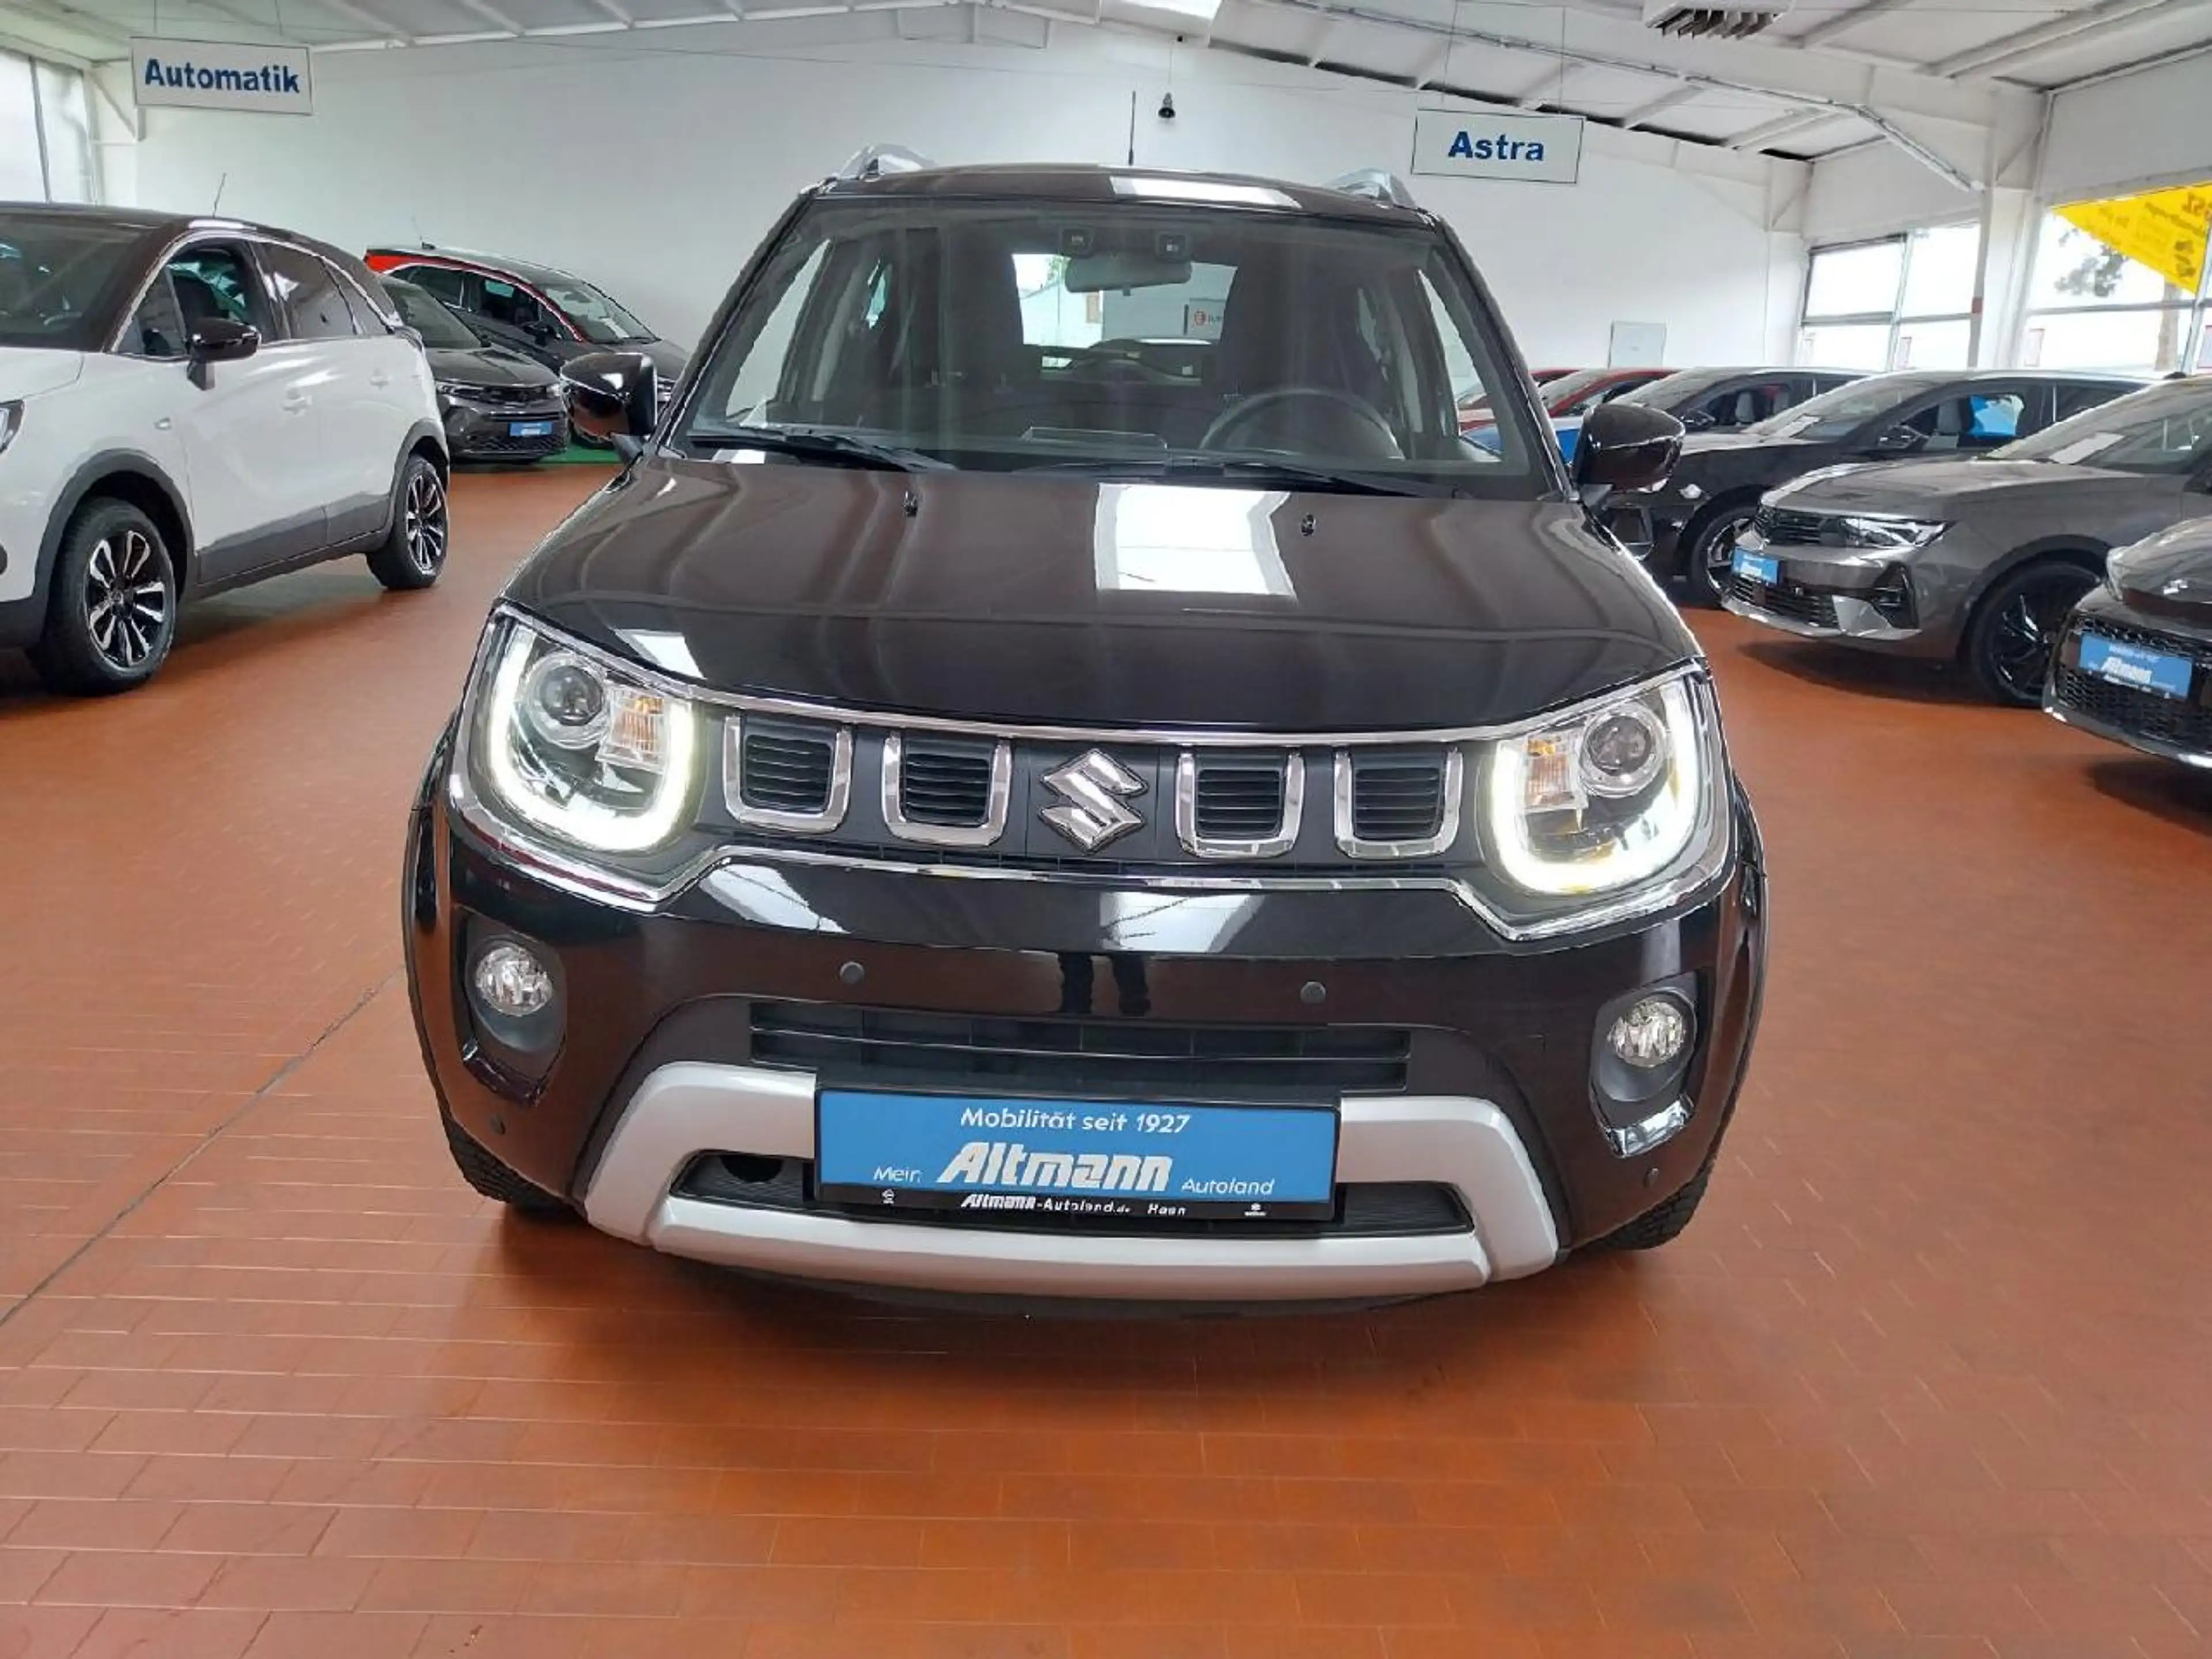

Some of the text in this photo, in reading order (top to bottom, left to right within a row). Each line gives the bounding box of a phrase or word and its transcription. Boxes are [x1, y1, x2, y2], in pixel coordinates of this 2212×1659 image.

[145, 58, 300, 93] Automatik
[1448, 131, 1544, 161] Astra
[960, 1107, 1191, 1134] Mobilität seit 1927
[936, 1141, 1173, 1192] Altmann
[1181, 1176, 1275, 1196] Autoland
